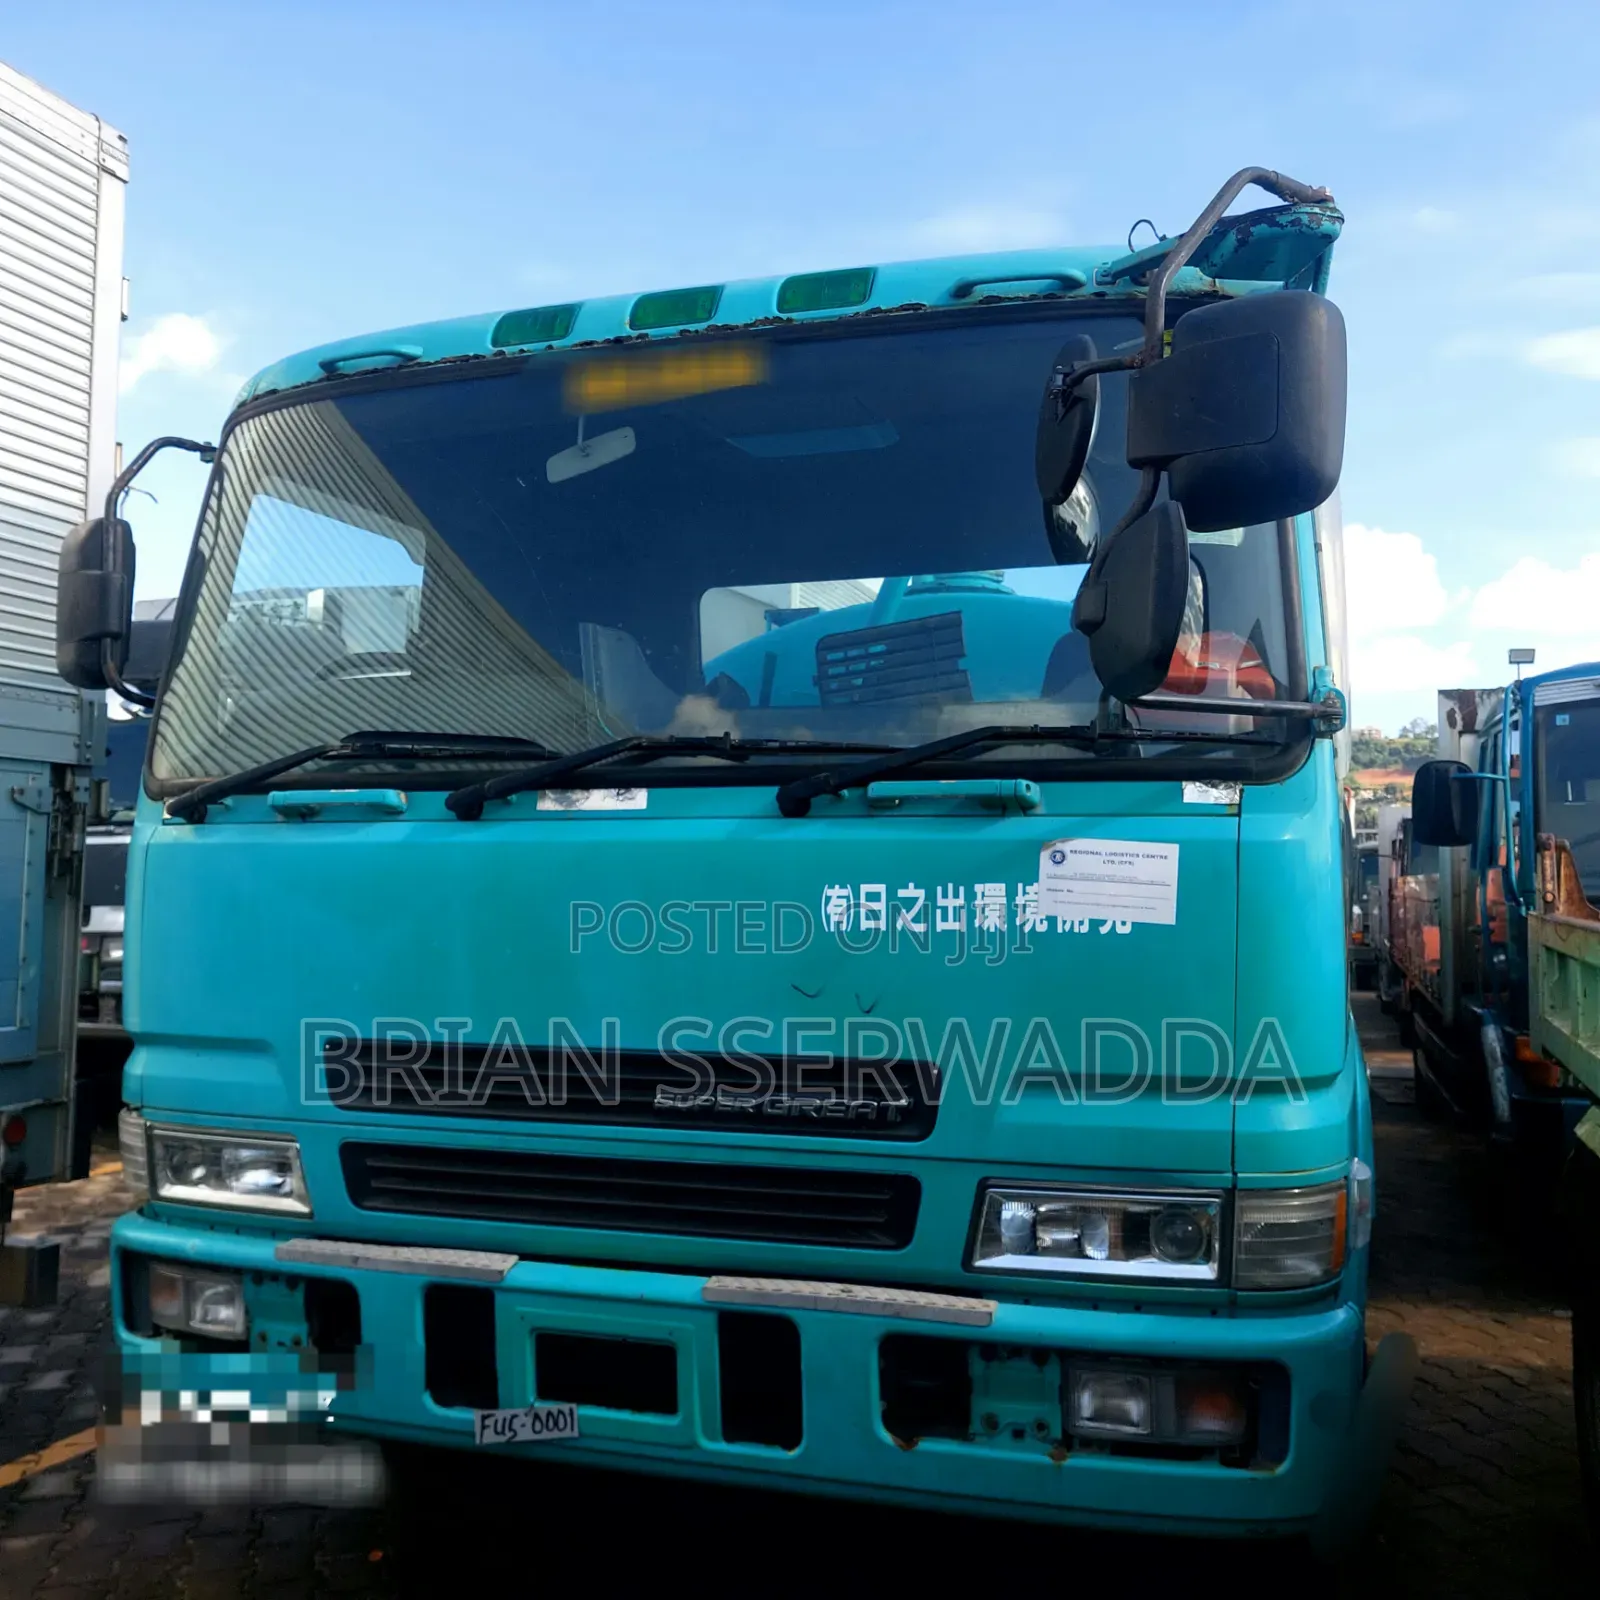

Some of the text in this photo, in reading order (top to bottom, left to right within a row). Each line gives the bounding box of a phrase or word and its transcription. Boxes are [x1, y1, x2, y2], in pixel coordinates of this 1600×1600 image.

[1069, 849, 1103, 857] REGIONAL
[1104, 851, 1140, 859] LOGISTICS
[653, 1093, 913, 1122] SUPER GREAT
